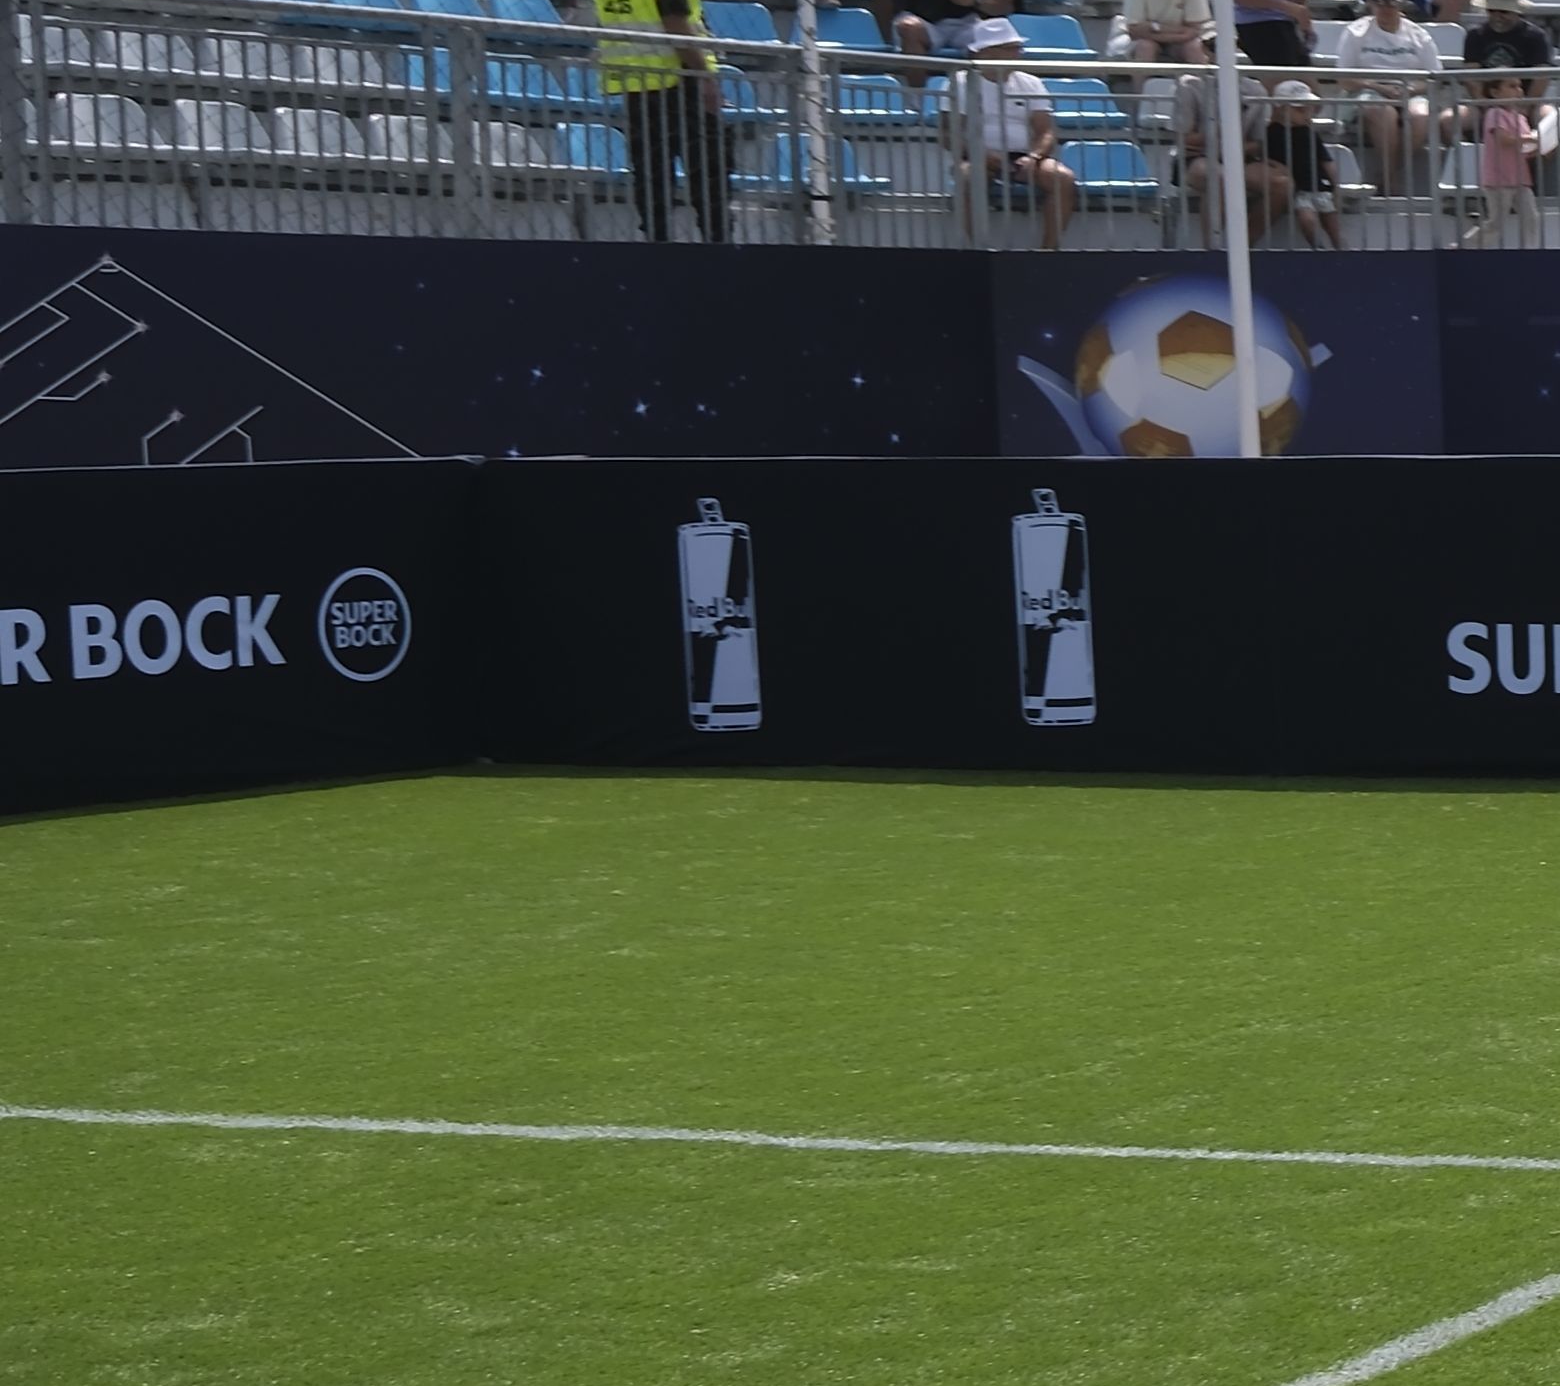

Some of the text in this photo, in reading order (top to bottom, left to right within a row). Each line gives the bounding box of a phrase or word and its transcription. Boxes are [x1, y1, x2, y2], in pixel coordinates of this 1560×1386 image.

[331, 600, 399, 627] SUPER
[69, 594, 287, 680] BOCK
[334, 623, 397, 649] BOCK
